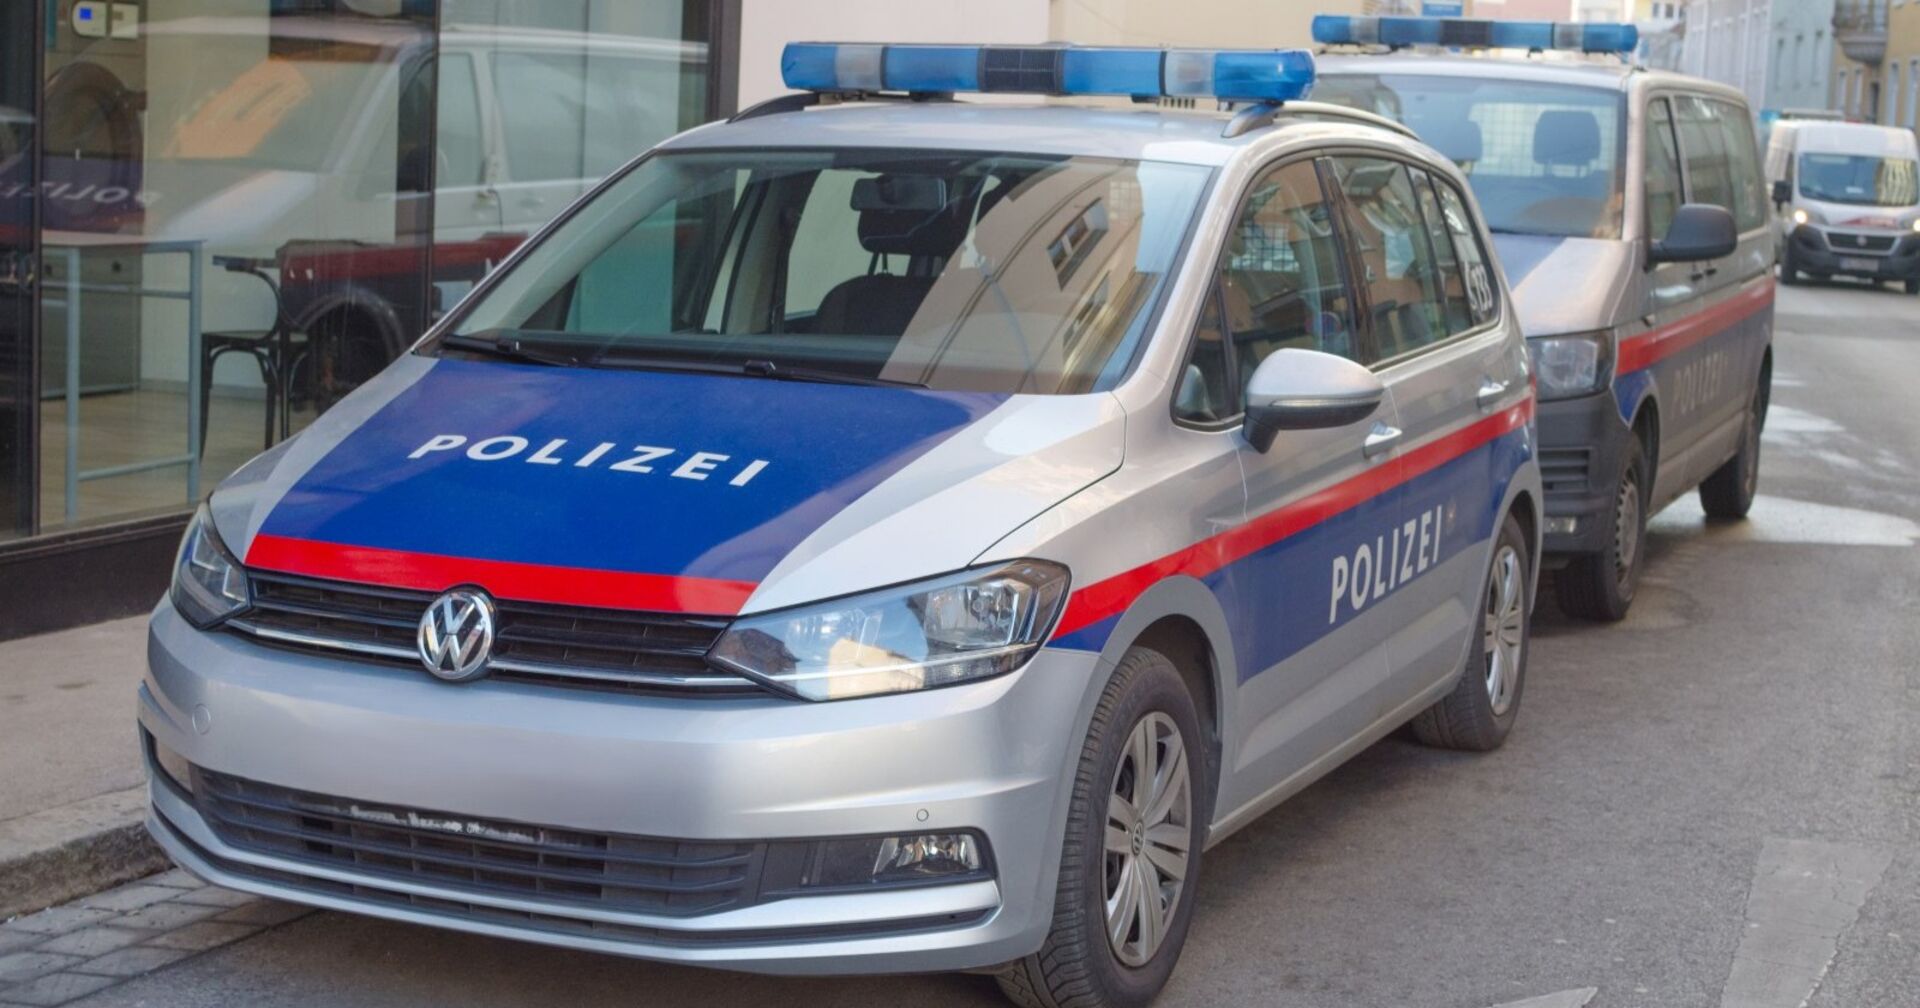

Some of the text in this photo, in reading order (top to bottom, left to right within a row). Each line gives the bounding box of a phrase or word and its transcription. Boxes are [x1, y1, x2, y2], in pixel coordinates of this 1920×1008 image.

[1671, 350, 1724, 417] POLIZEI
[407, 434, 769, 487] POLIZEI
[1329, 504, 1442, 625] POLIZEI
[418, 592, 492, 679] VW
